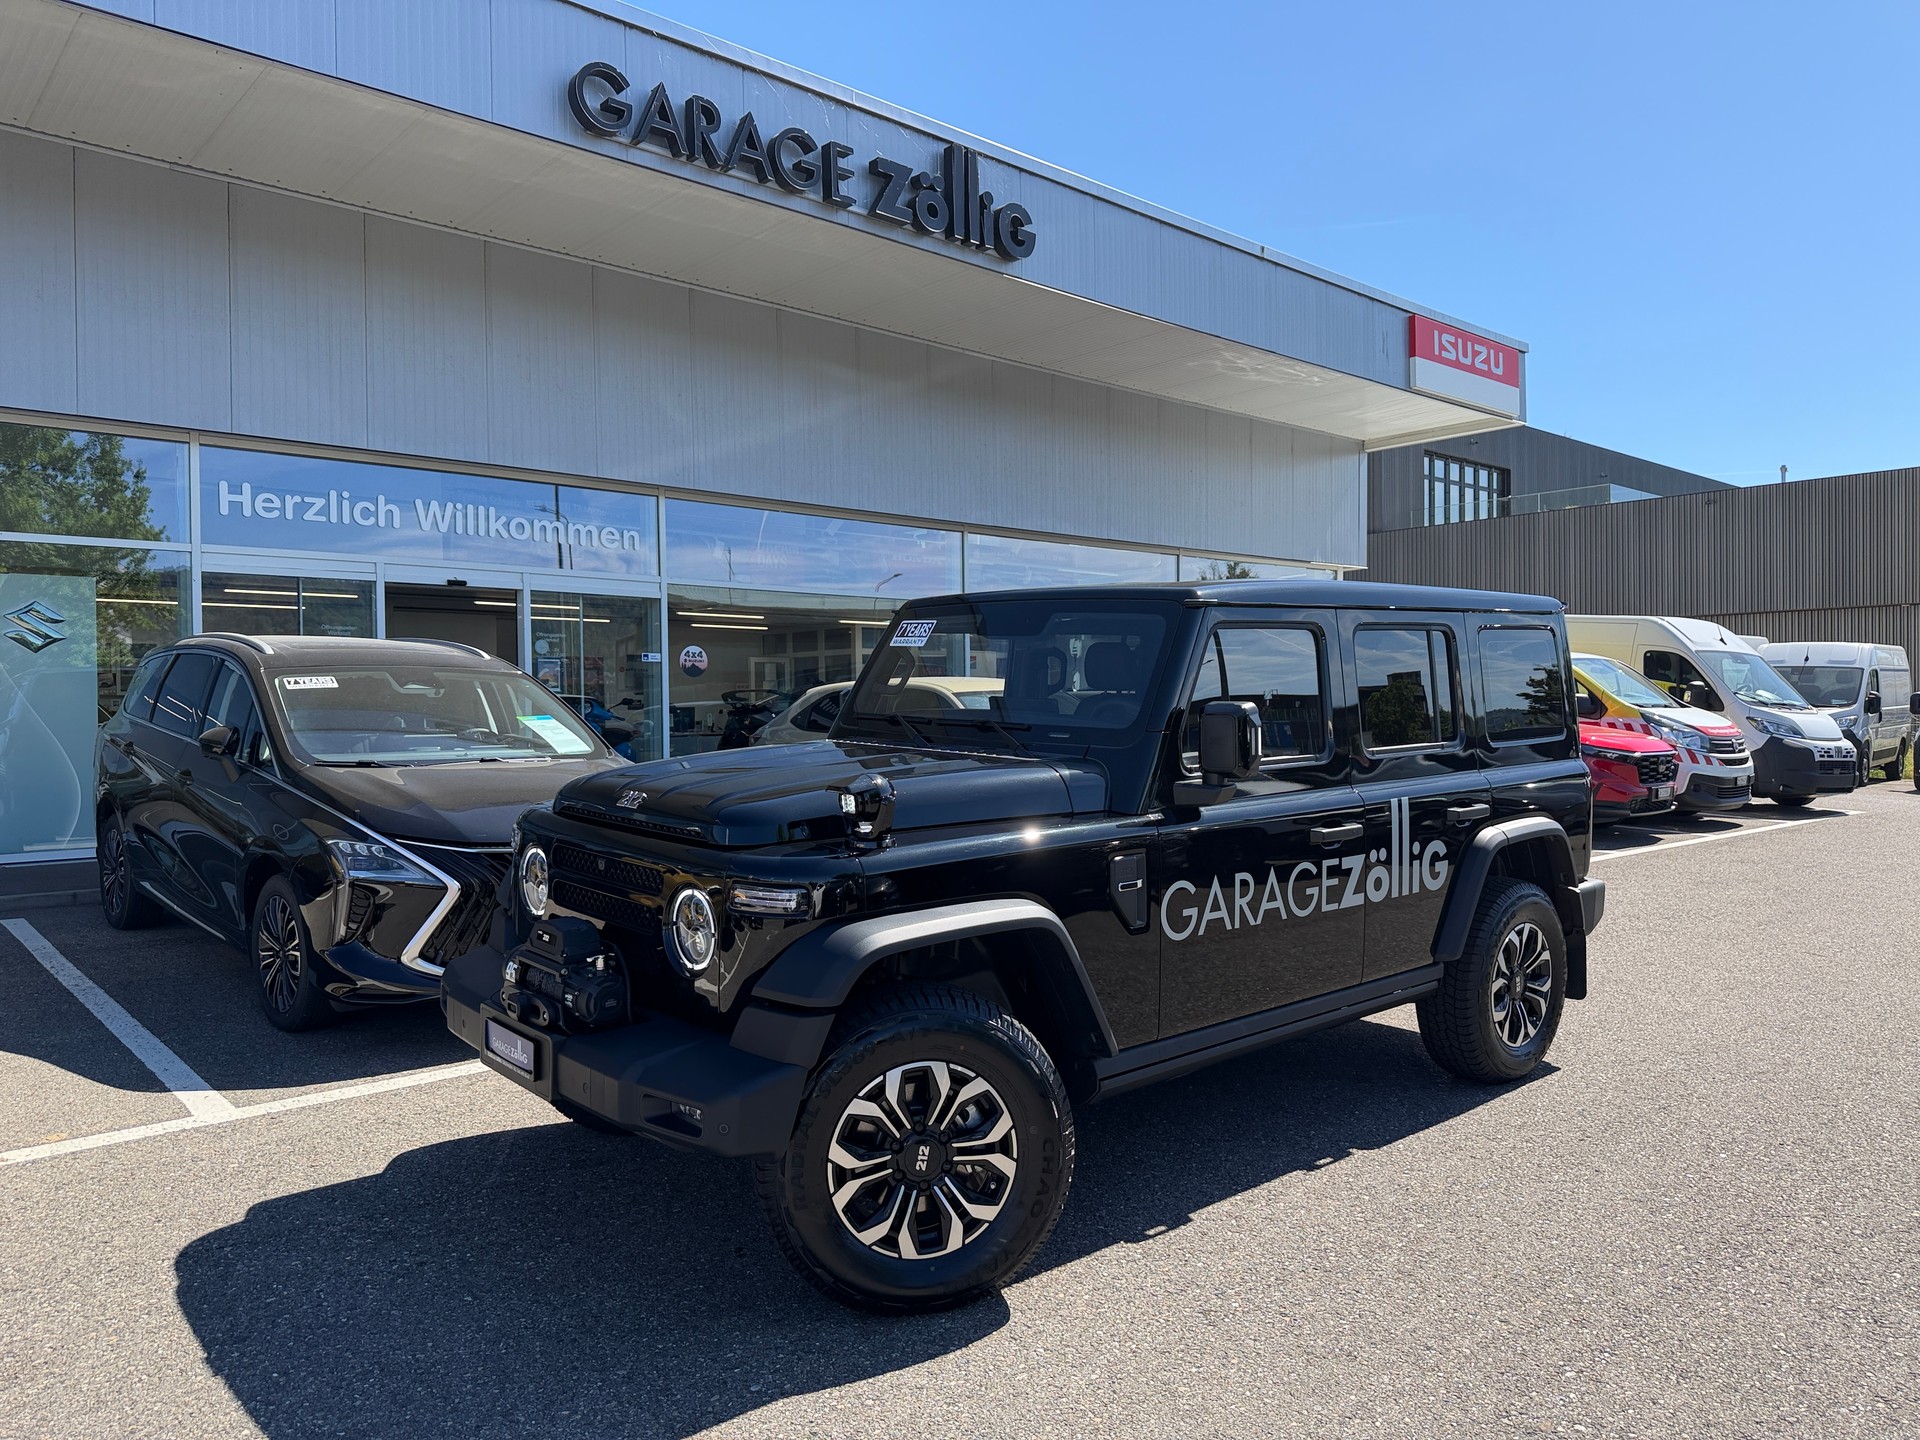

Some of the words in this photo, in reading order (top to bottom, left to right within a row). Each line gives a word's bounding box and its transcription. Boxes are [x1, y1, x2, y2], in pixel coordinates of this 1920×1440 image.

[567, 61, 857, 209] GARAGE
[1433, 330, 1503, 376] ISUZU
[218, 480, 400, 529] Herzlich
[413, 498, 641, 551] Willkommen
[898, 623, 908, 637] 7
[904, 623, 933, 637] YEARS
[684, 650, 704, 659] 4x4
[915, 1145, 930, 1171] 212
